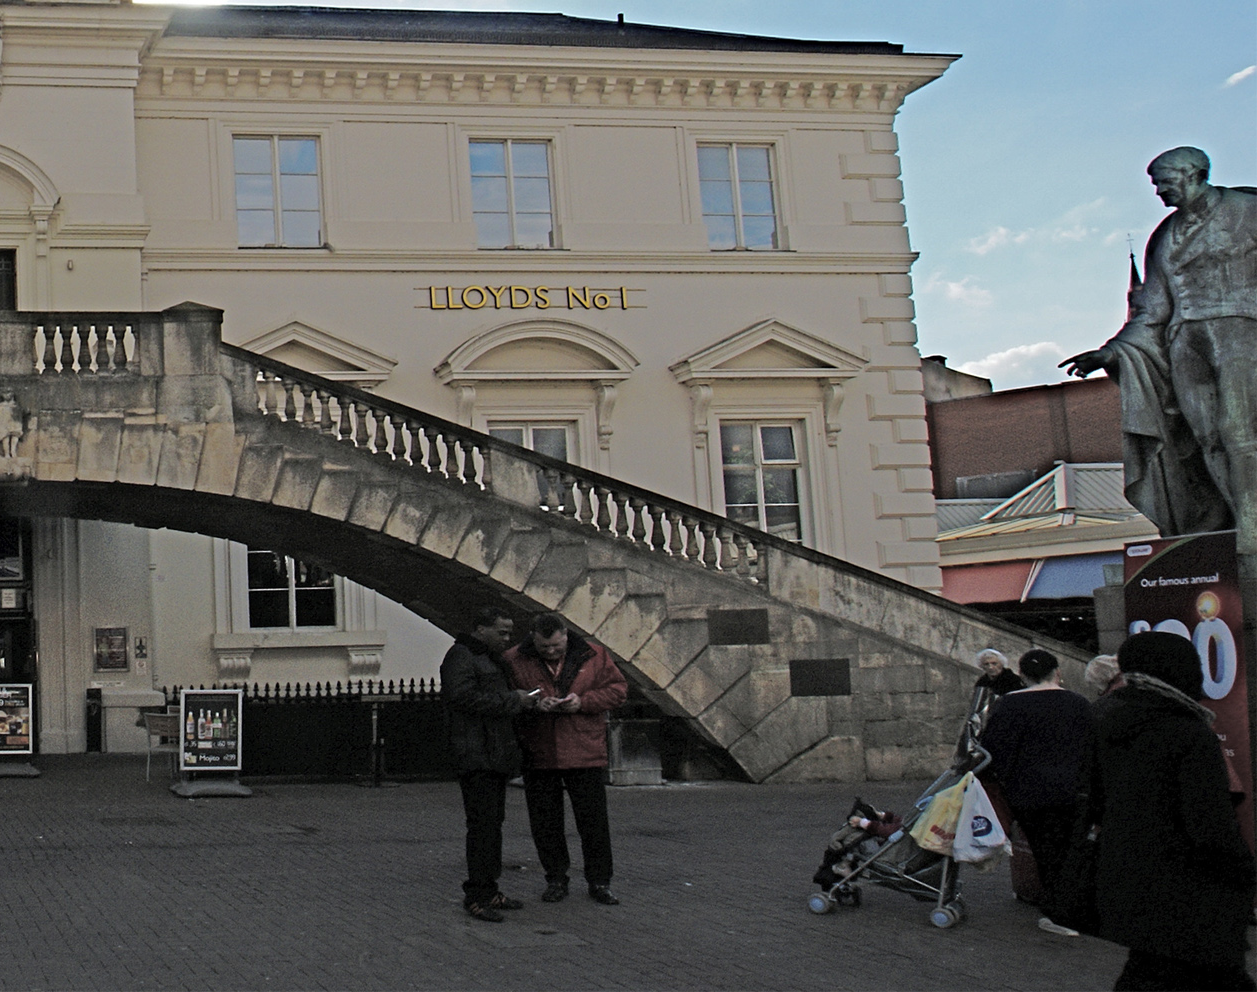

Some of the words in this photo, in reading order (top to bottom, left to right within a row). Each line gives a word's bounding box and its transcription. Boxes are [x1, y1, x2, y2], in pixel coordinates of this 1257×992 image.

[429, 285, 551, 309] LLOYDS
[1140, 578, 1157, 587] Our
[1158, 576, 1189, 586] famous
[1190, 572, 1219, 584] annual
